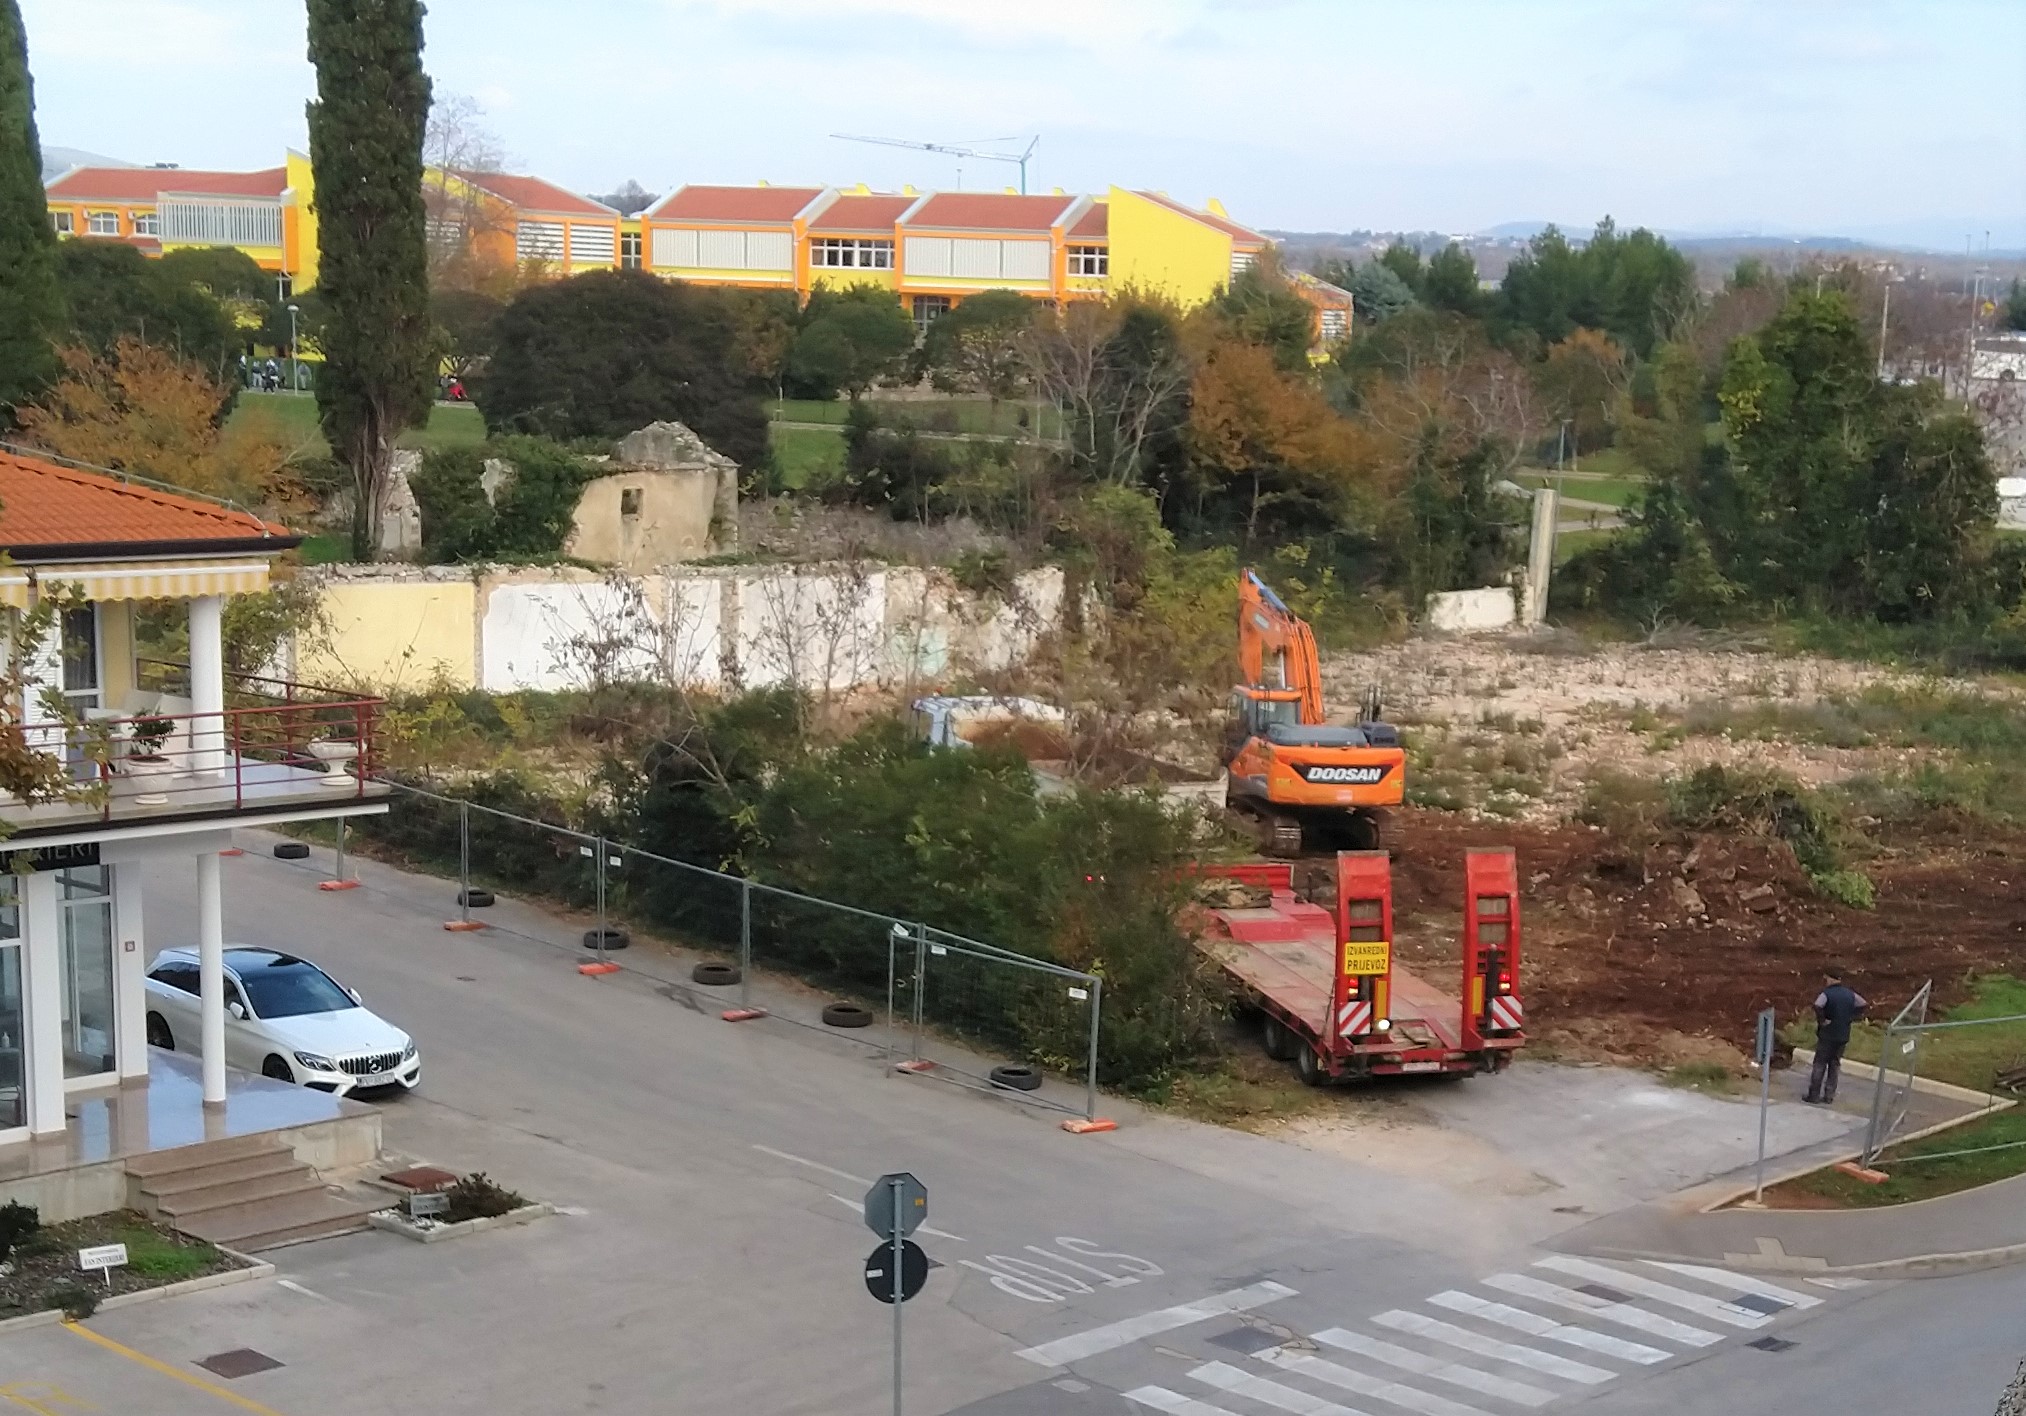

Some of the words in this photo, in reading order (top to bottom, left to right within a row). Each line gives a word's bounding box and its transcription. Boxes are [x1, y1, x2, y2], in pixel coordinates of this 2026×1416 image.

[1306, 767, 1381, 781] DOOSAN
[1347, 959, 1386, 971] PRIJEVOZ
[957, 1236, 1165, 1304] STOP
